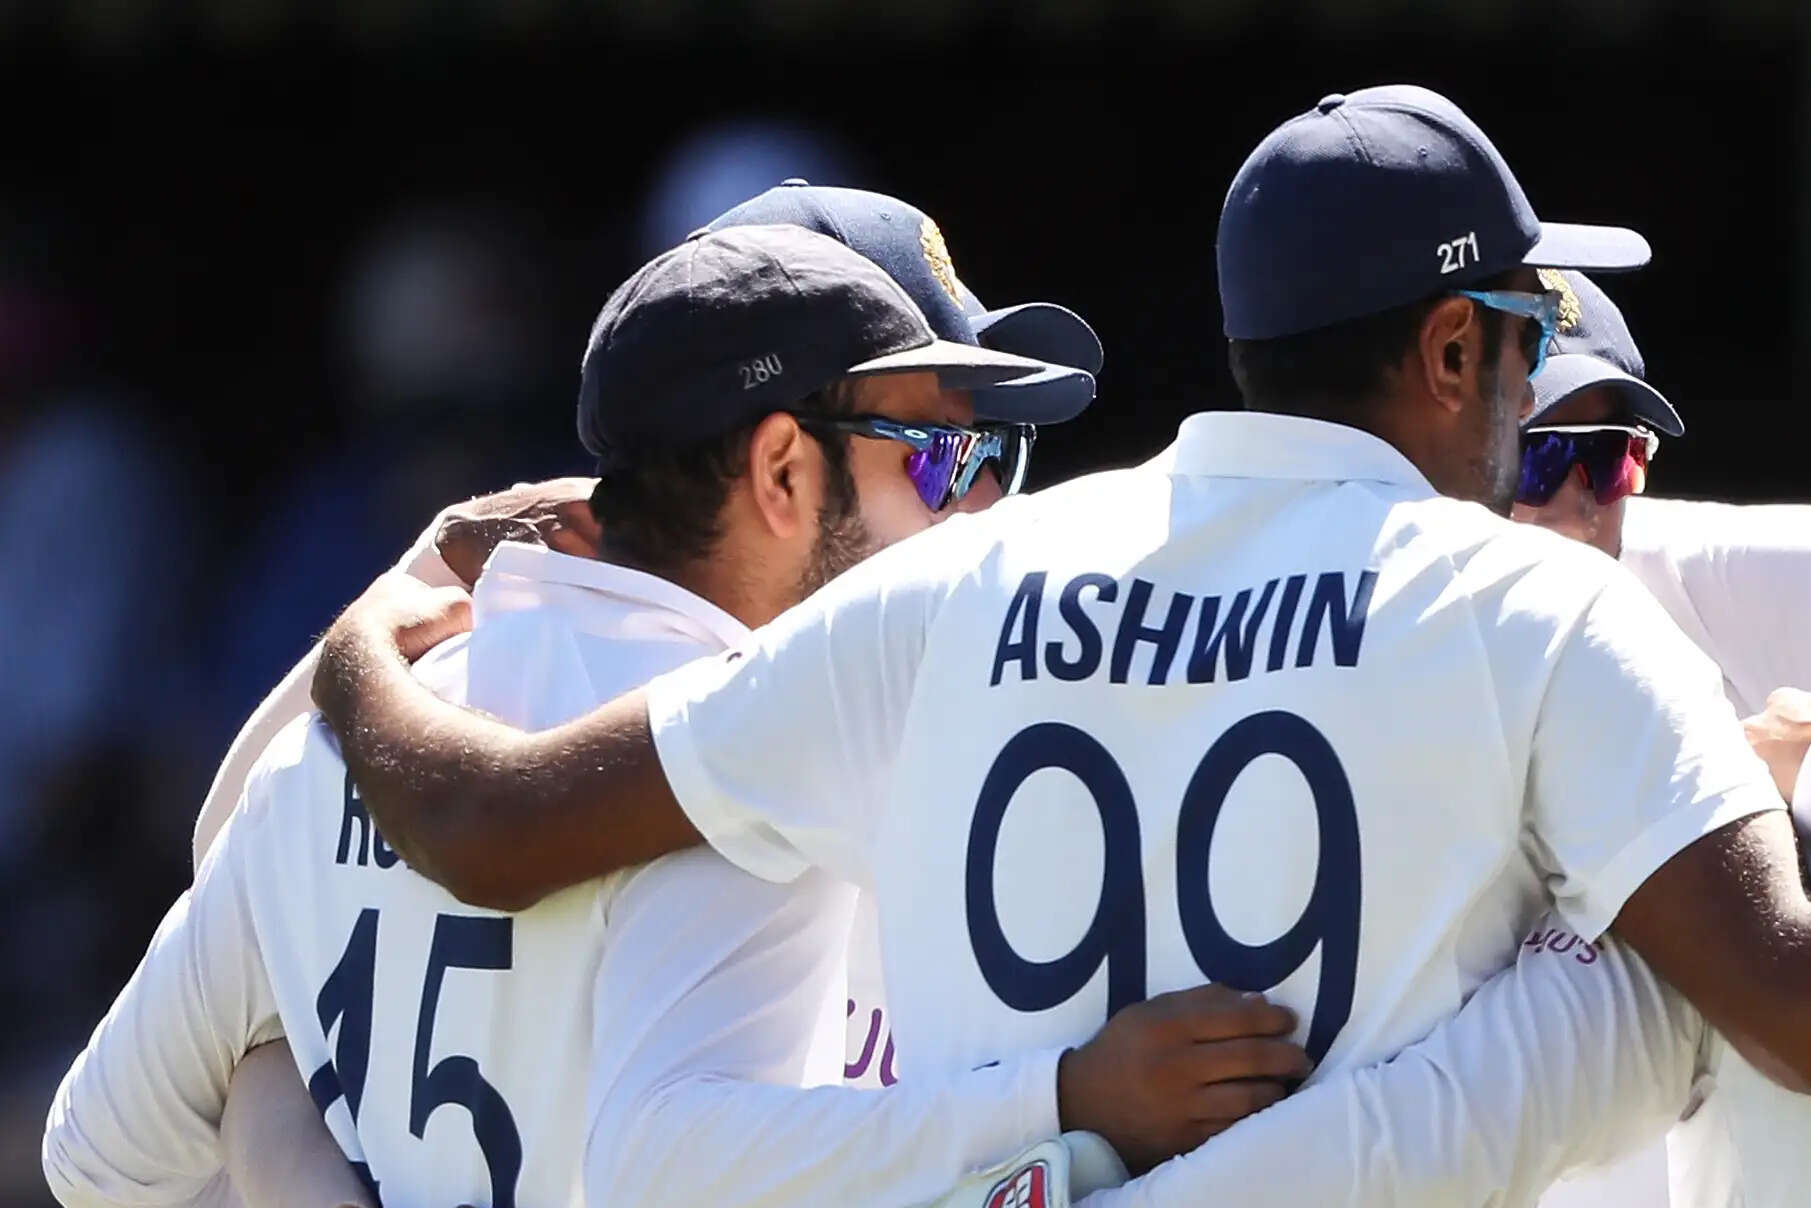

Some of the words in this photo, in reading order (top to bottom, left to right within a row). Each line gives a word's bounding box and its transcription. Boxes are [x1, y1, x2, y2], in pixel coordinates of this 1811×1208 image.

[1436, 231, 1481, 274] 271
[738, 353, 783, 390] 280
[989, 570, 1380, 687] ASHWIN
[964, 709, 1363, 1096] 99
